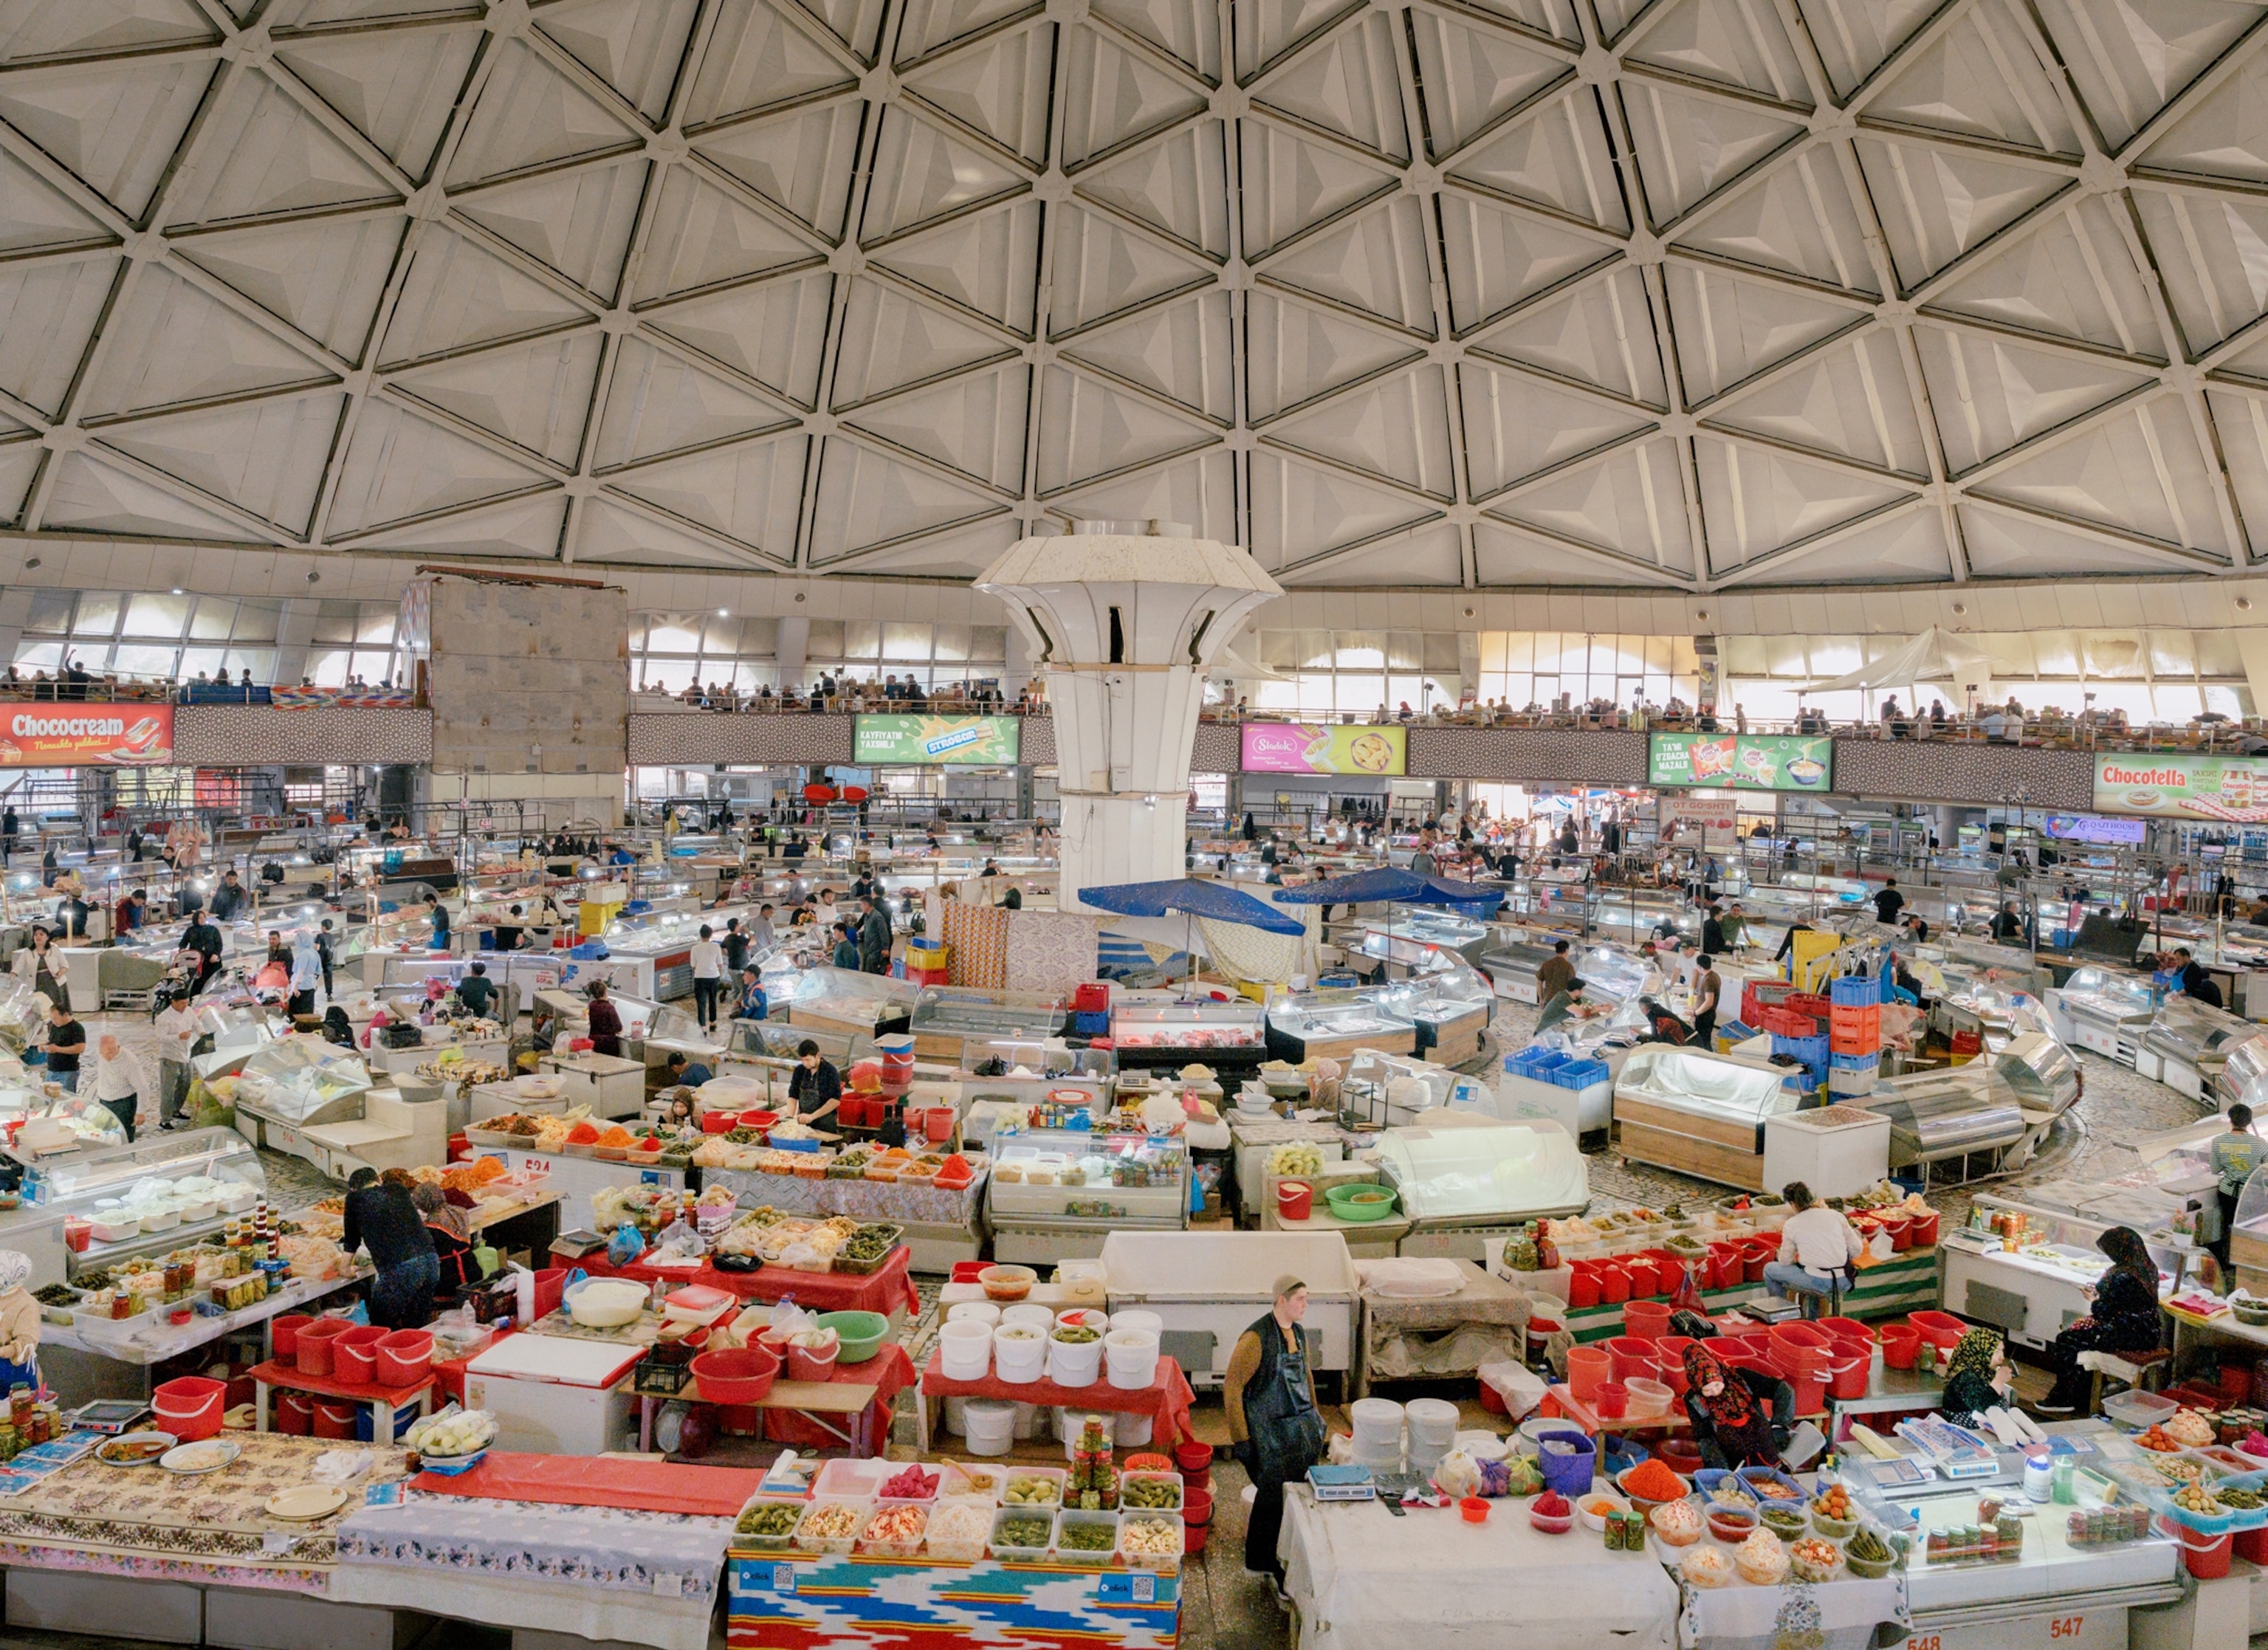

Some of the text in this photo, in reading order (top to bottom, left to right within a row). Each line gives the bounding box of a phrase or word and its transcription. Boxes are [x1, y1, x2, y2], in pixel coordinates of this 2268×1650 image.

[12, 715, 123, 736] Chococream
[1258, 738, 1293, 752] Sladok
[2103, 766, 2186, 787] Chocotella
[1673, 801, 1686, 809] OT
[2090, 821, 2109, 829] QAZI
[2111, 822, 2137, 831] HOUSE
[751, 1572, 769, 1581] click
[1109, 1584, 1128, 1592] click
[2050, 1617, 2083, 1639] 547
[1907, 1636, 1941, 1650] 548
